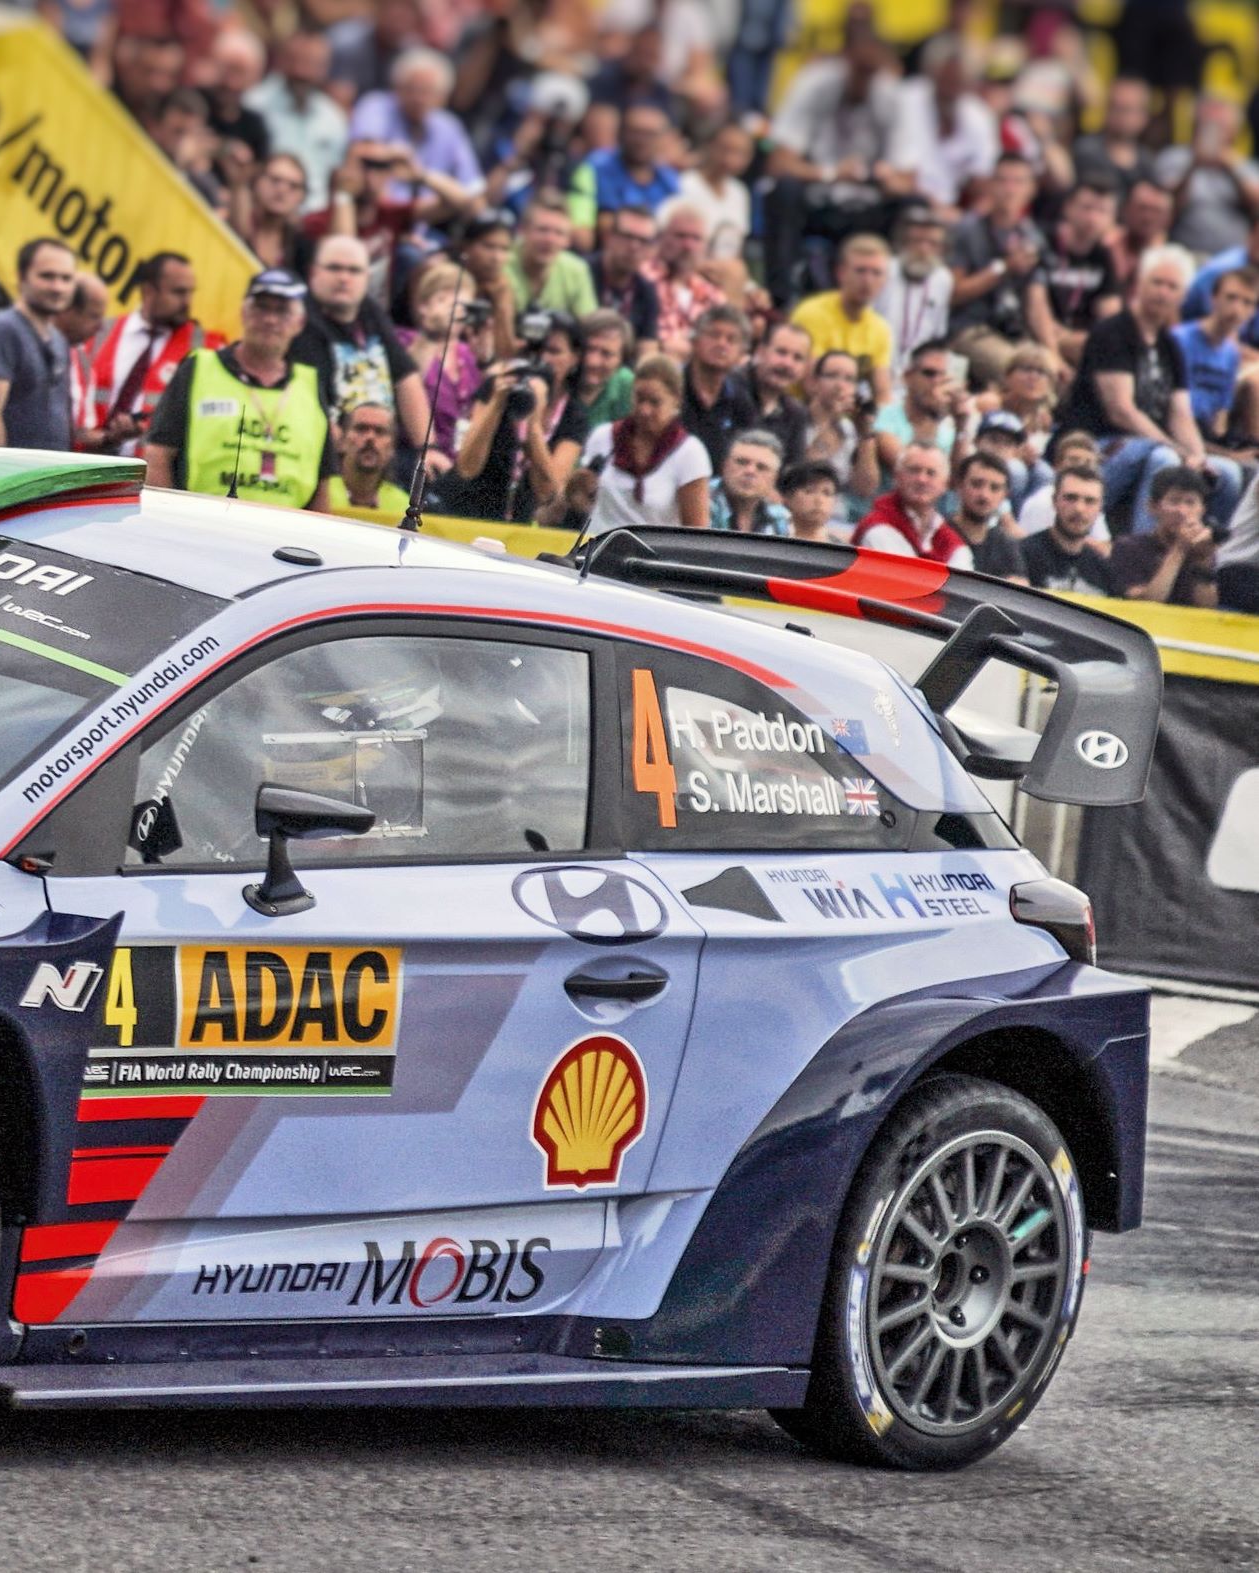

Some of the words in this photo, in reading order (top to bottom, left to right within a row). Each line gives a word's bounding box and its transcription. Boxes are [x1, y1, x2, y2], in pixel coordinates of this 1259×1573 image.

[237, 419, 289, 443] ADC
[21, 635, 221, 804] motorsport.hyundai.com
[632, 668, 678, 829] 4
[667, 708, 706, 749] H.
[709, 710, 826, 754] Paddon
[689, 771, 720, 814] S.
[725, 772, 842, 816] Marshall
[765, 868, 831, 883] HYUNDAI
[909, 873, 997, 893] HYUNDAI
[923, 898, 991, 916] STEEL
[104, 947, 138, 1047] 4
[188, 950, 391, 1044] ADAC
[118, 1063, 142, 1082] FIA
[145, 1063, 185, 1081] World
[187, 1063, 223, 1083] Rally
[225, 1063, 321, 1084] Championship
[192, 1261, 351, 1296] HYUNDAI
[346, 1236, 553, 1308] MOBIS
